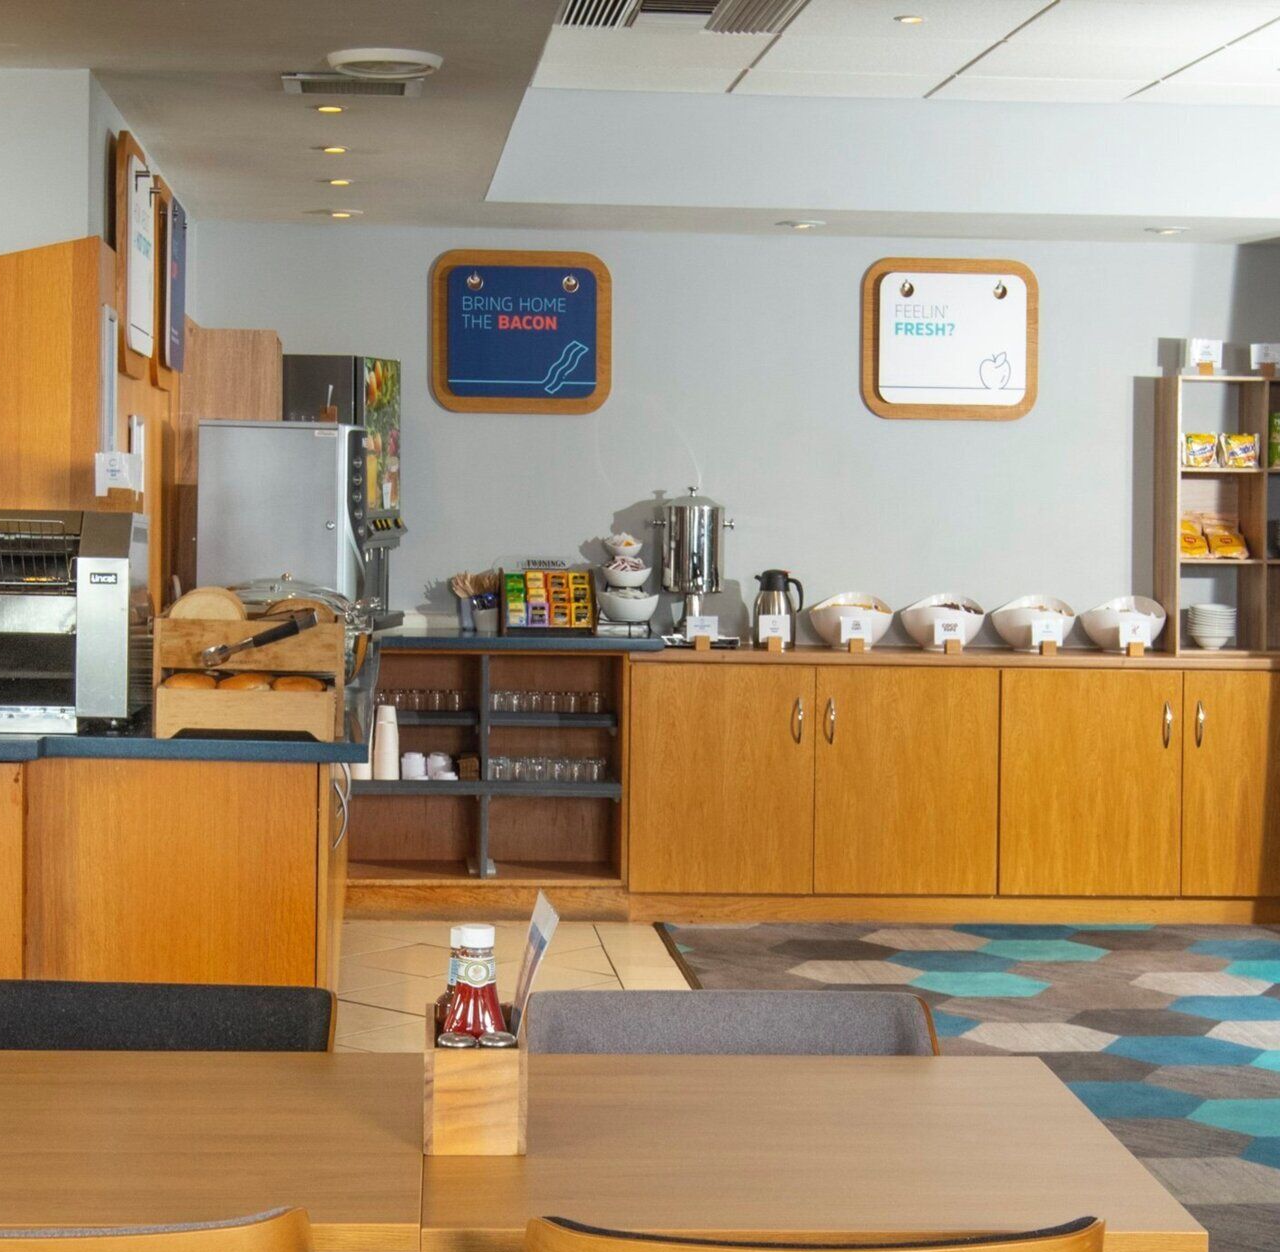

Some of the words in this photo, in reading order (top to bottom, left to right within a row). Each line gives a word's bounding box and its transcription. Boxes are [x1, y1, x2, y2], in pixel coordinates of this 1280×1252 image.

[461, 296, 513, 312] BRING
[519, 297, 567, 313] HOME
[894, 303, 950, 320] FEELIN'
[461, 314, 493, 330] THE
[497, 315, 558, 331] BACON
[894, 321, 956, 337] FRESH?
[526, 559, 566, 568] TWININGS
